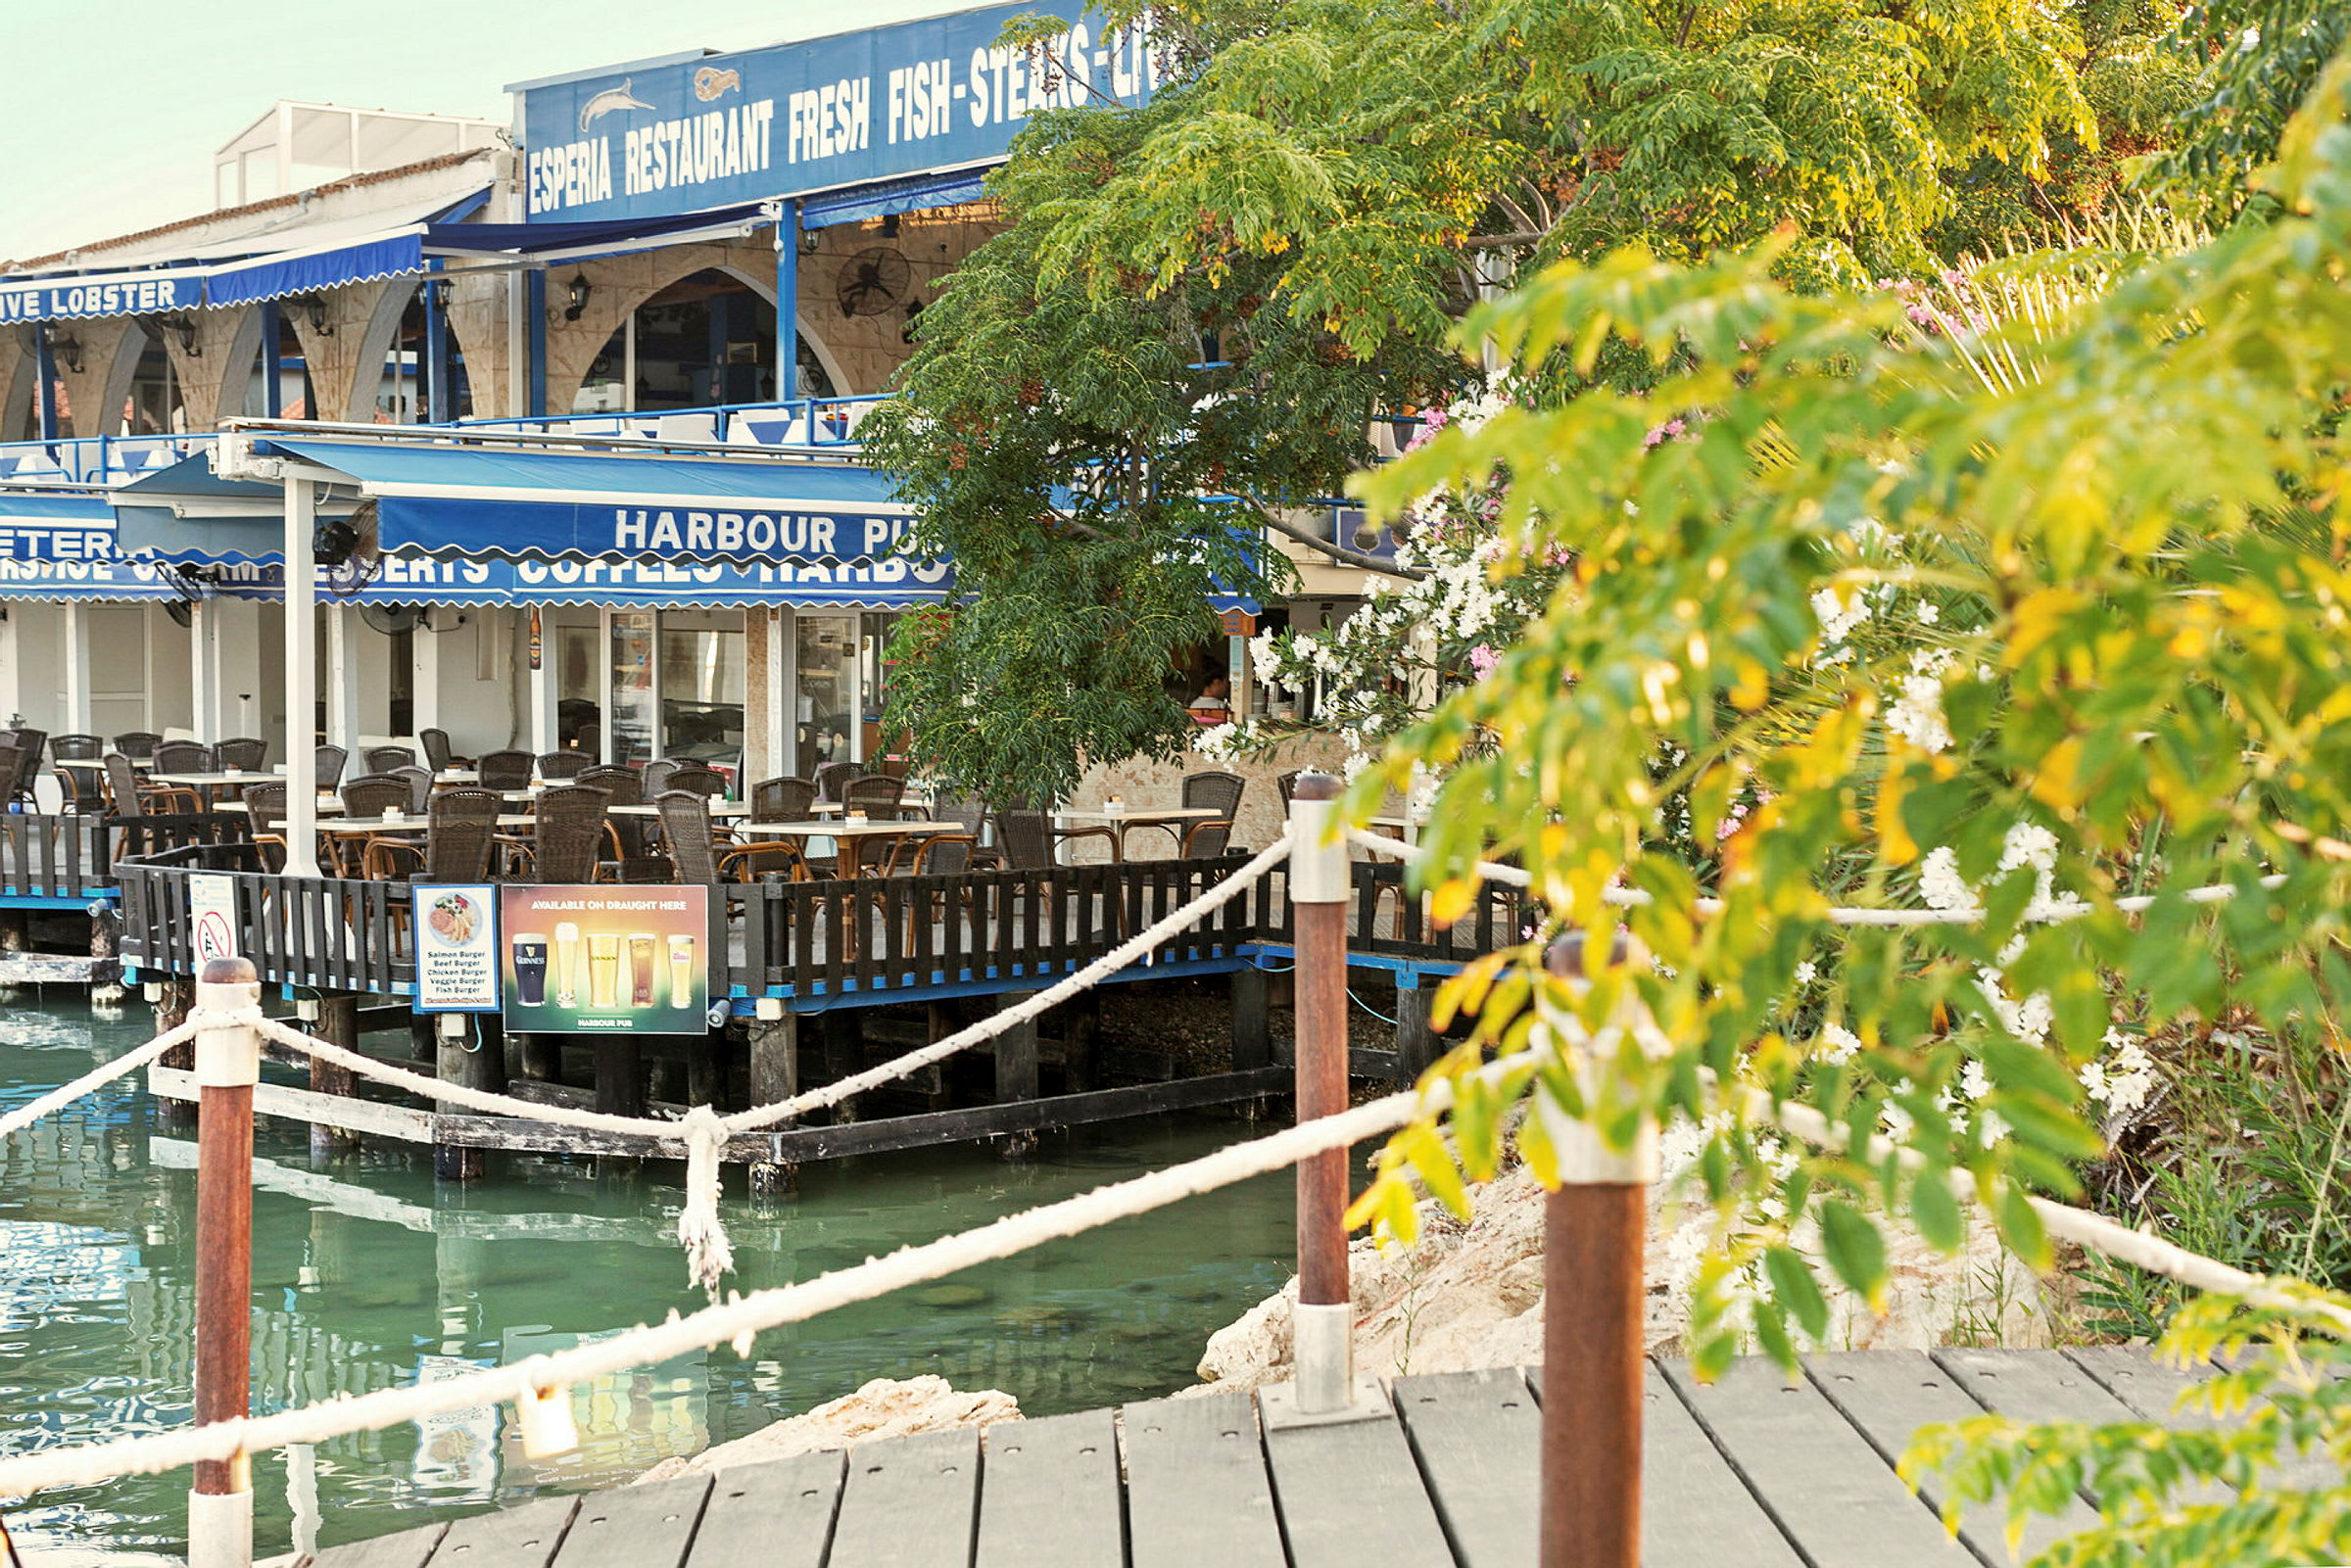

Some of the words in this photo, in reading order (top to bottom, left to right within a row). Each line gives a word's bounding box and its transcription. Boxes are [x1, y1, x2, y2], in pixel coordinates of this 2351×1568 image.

[529, 136, 612, 214] ESPERIA
[625, 99, 774, 196] RESTAURANT
[789, 76, 870, 164] FRESH
[51, 279, 175, 313] LOBSTER
[615, 509, 836, 553] HARBOUR
[531, 900, 586, 910] AVAILABLE
[588, 900, 604, 910] ON
[606, 900, 657, 910] DRAUGHT
[659, 901, 687, 910] HERE
[578, 1019, 616, 1027] HARBOUR
[617, 1019, 634, 1027] PUB
